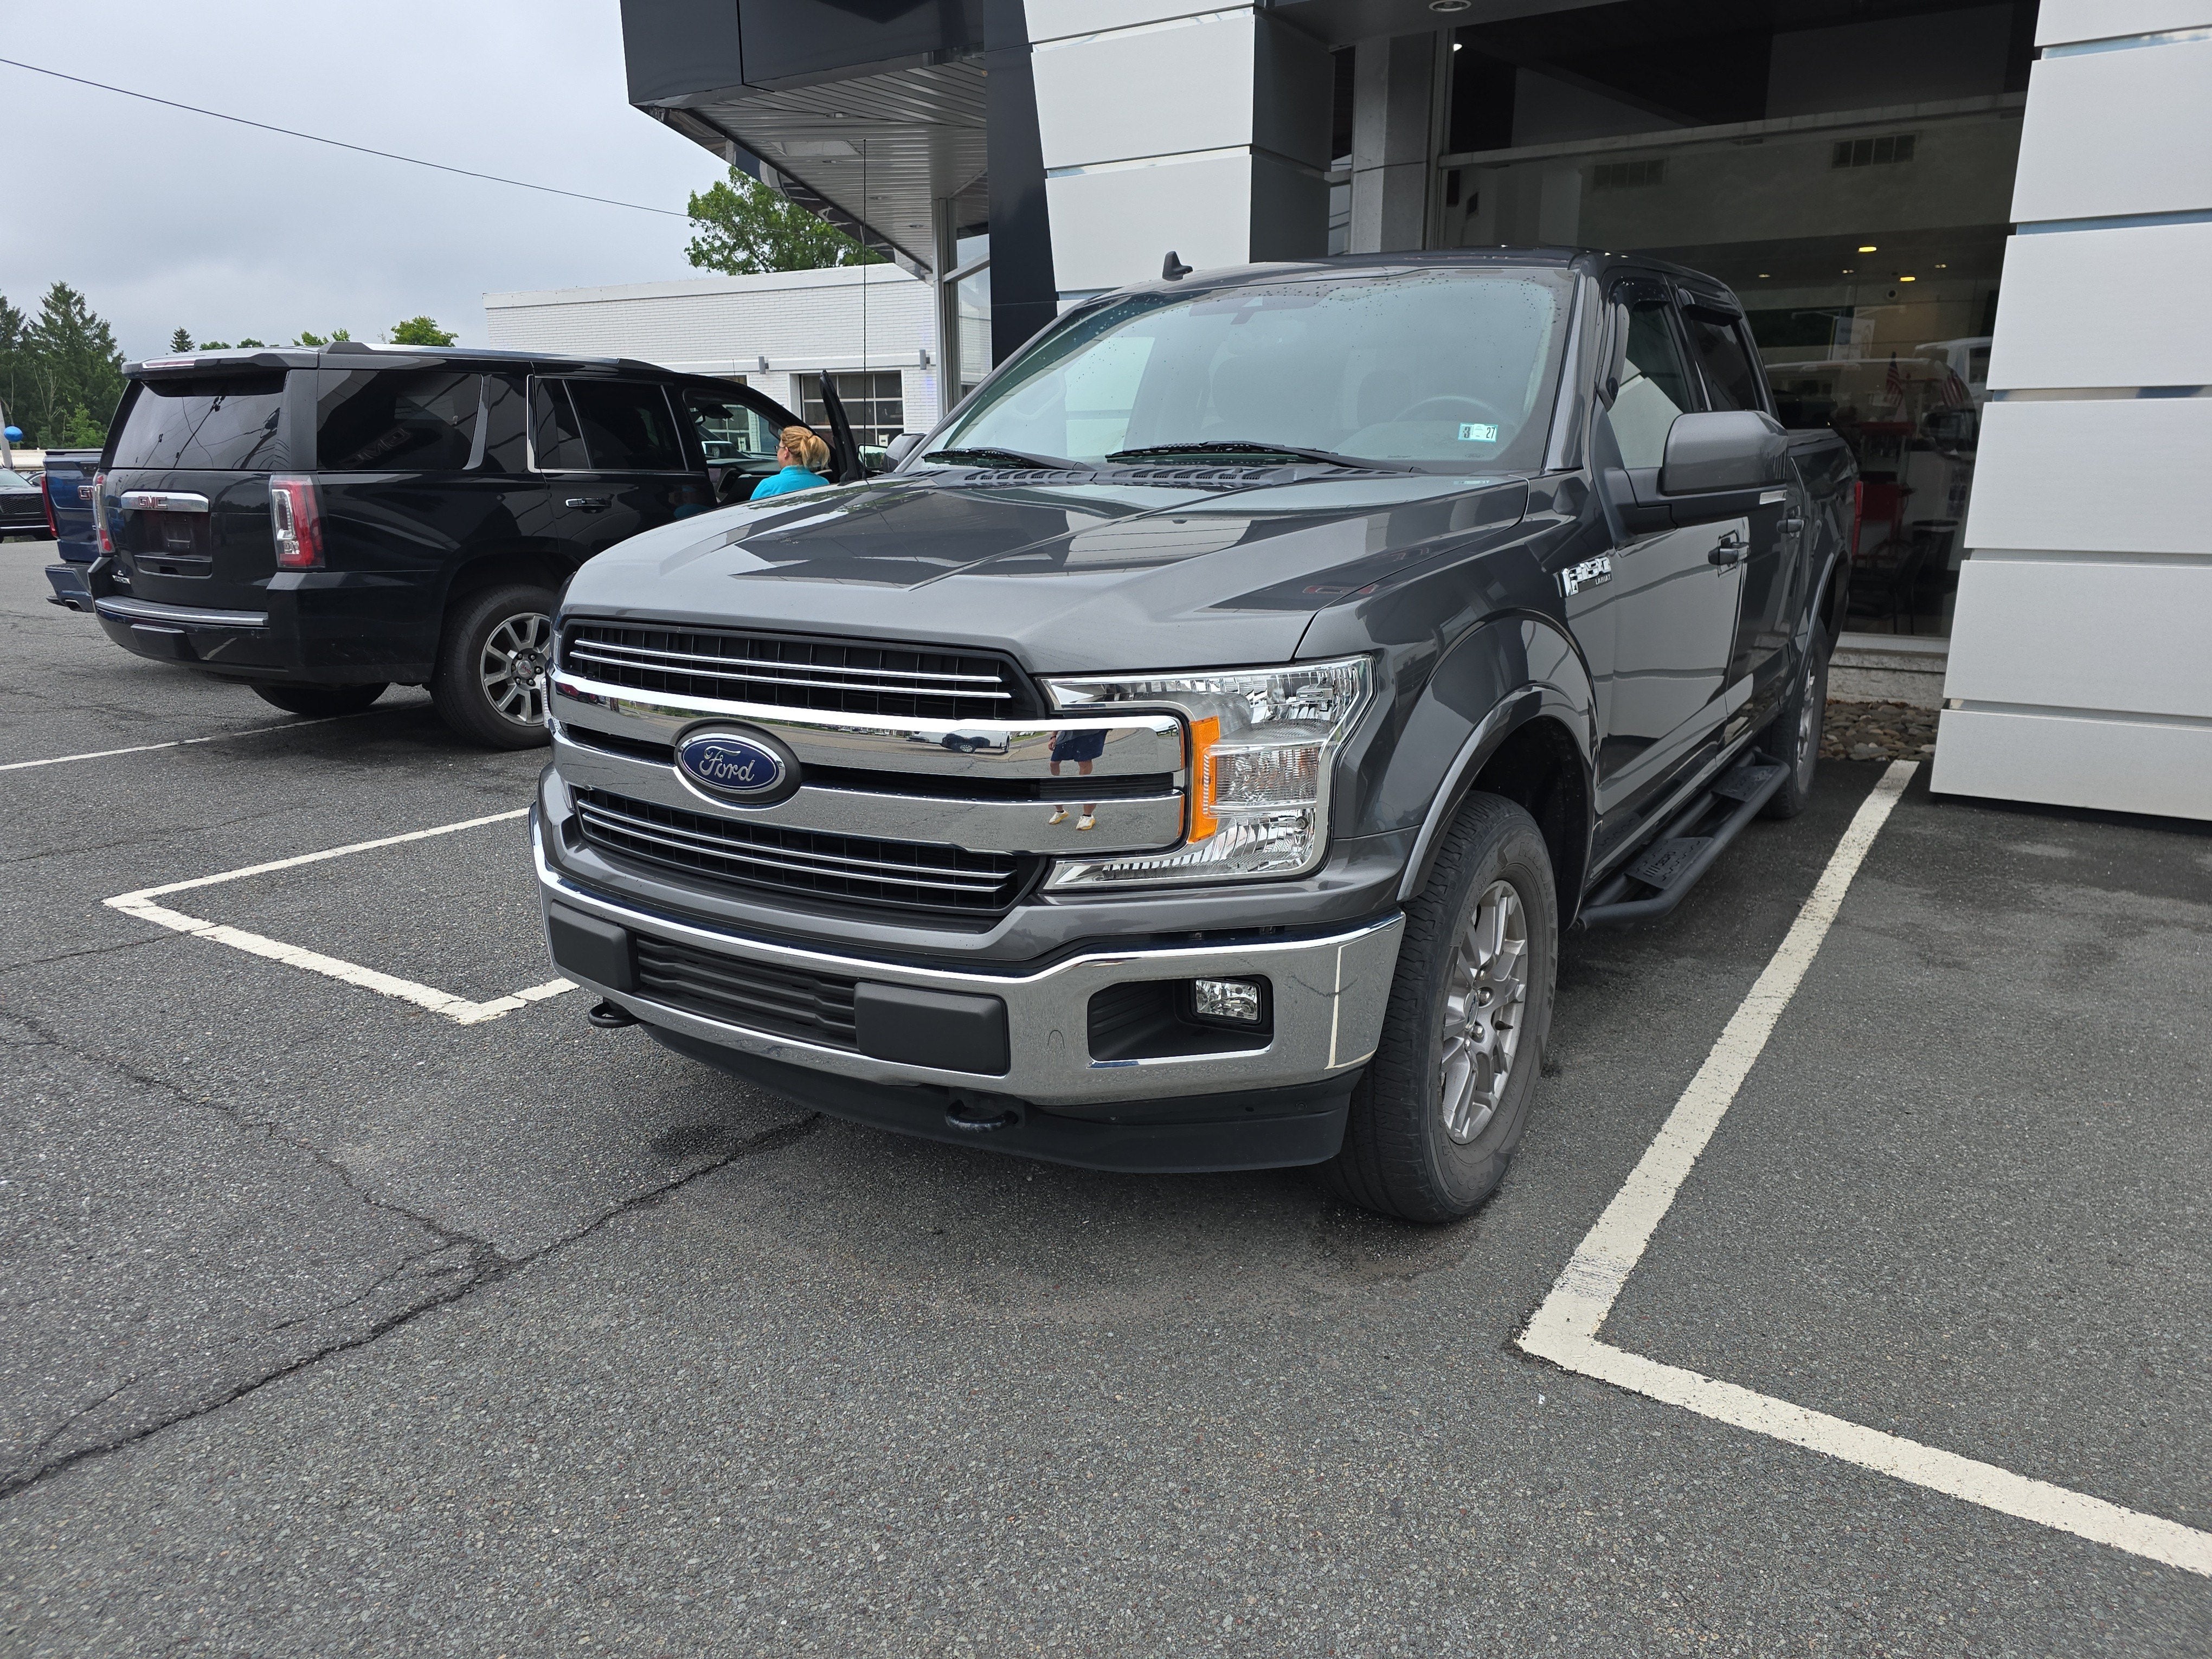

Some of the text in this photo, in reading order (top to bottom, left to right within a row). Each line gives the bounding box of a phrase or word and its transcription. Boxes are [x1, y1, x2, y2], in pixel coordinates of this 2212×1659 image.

[1486, 427, 1495, 439] 27
[138, 496, 169, 510] GMC
[1595, 574, 1611, 585] LARIAT
[699, 745, 756, 782] Ford
[1518, 841, 1557, 1009] WRANGLER
